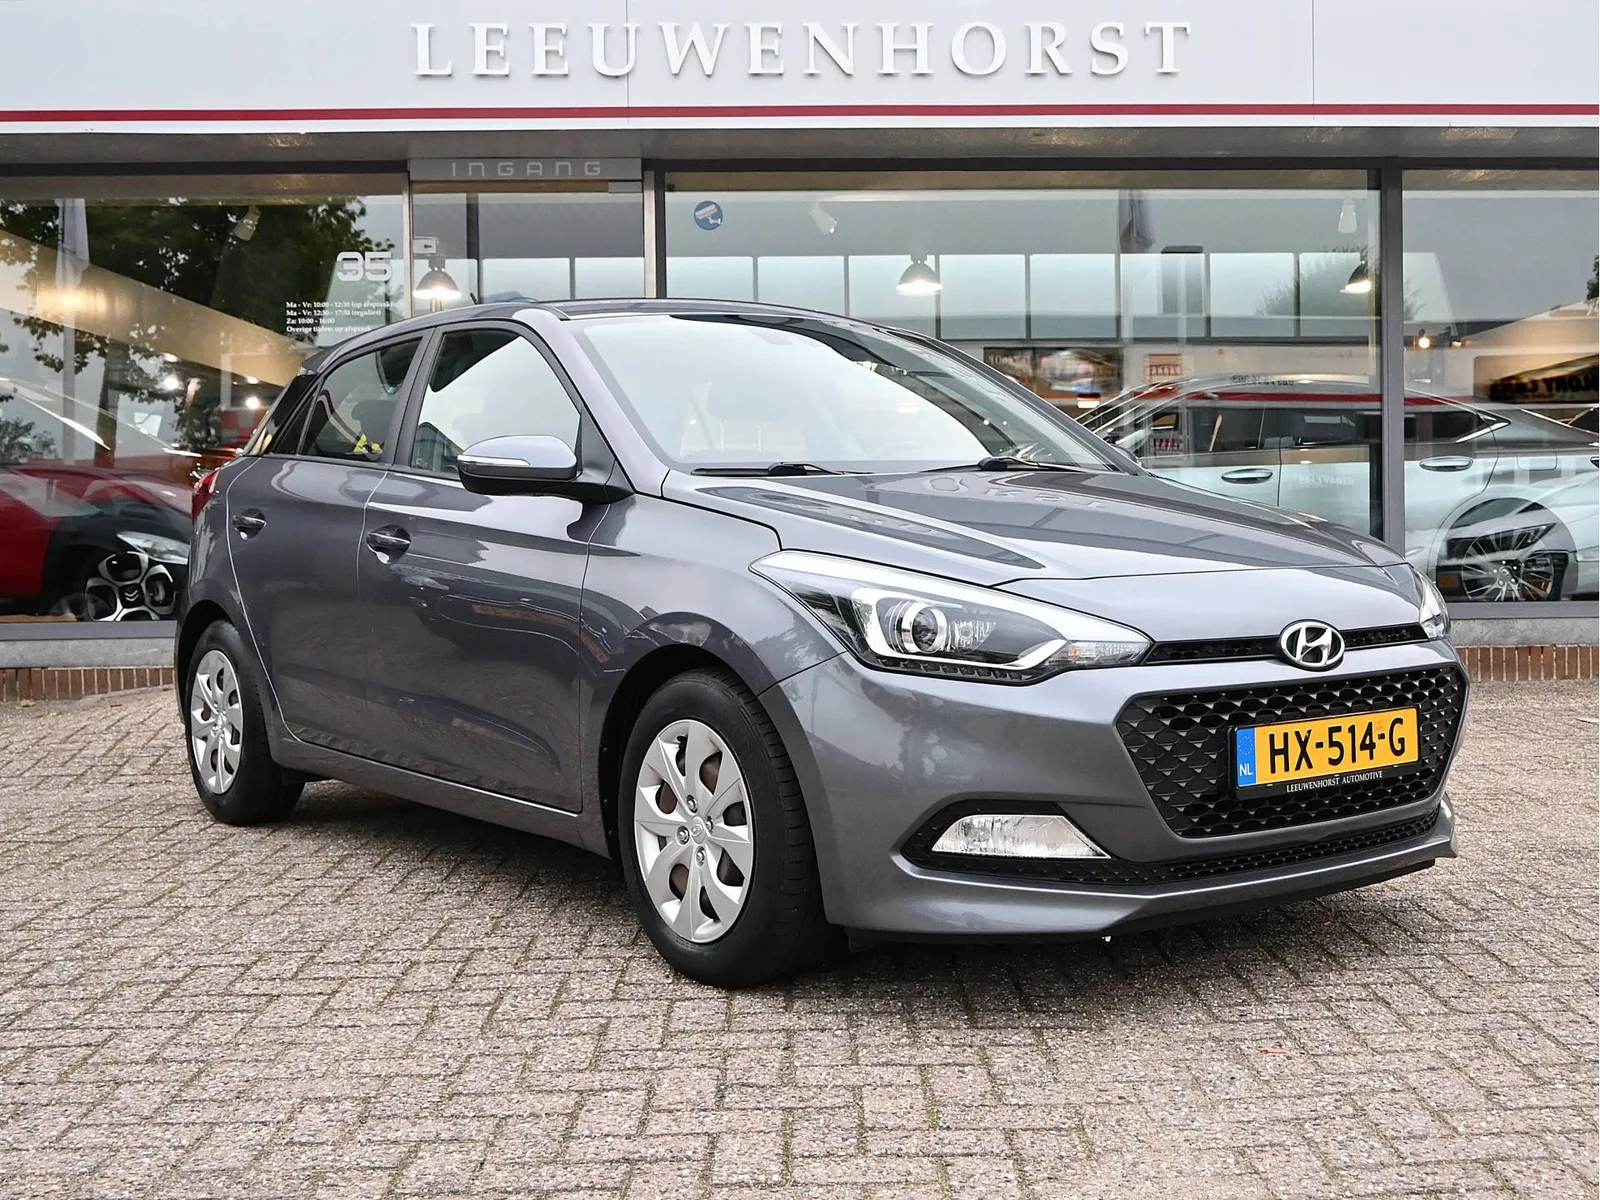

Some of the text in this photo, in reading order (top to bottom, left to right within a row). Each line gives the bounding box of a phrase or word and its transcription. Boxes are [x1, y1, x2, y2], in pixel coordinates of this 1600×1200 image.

[411, 22, 1191, 77] LEEUWENHORST
[451, 160, 601, 177] INGANG
[337, 252, 392, 281] 35
[286, 325, 312, 333] Overige
[1239, 717, 1406, 777] NL HX-514-G
[1286, 770, 1383, 793] LEEUWENHORST AUTOMOTIVE
